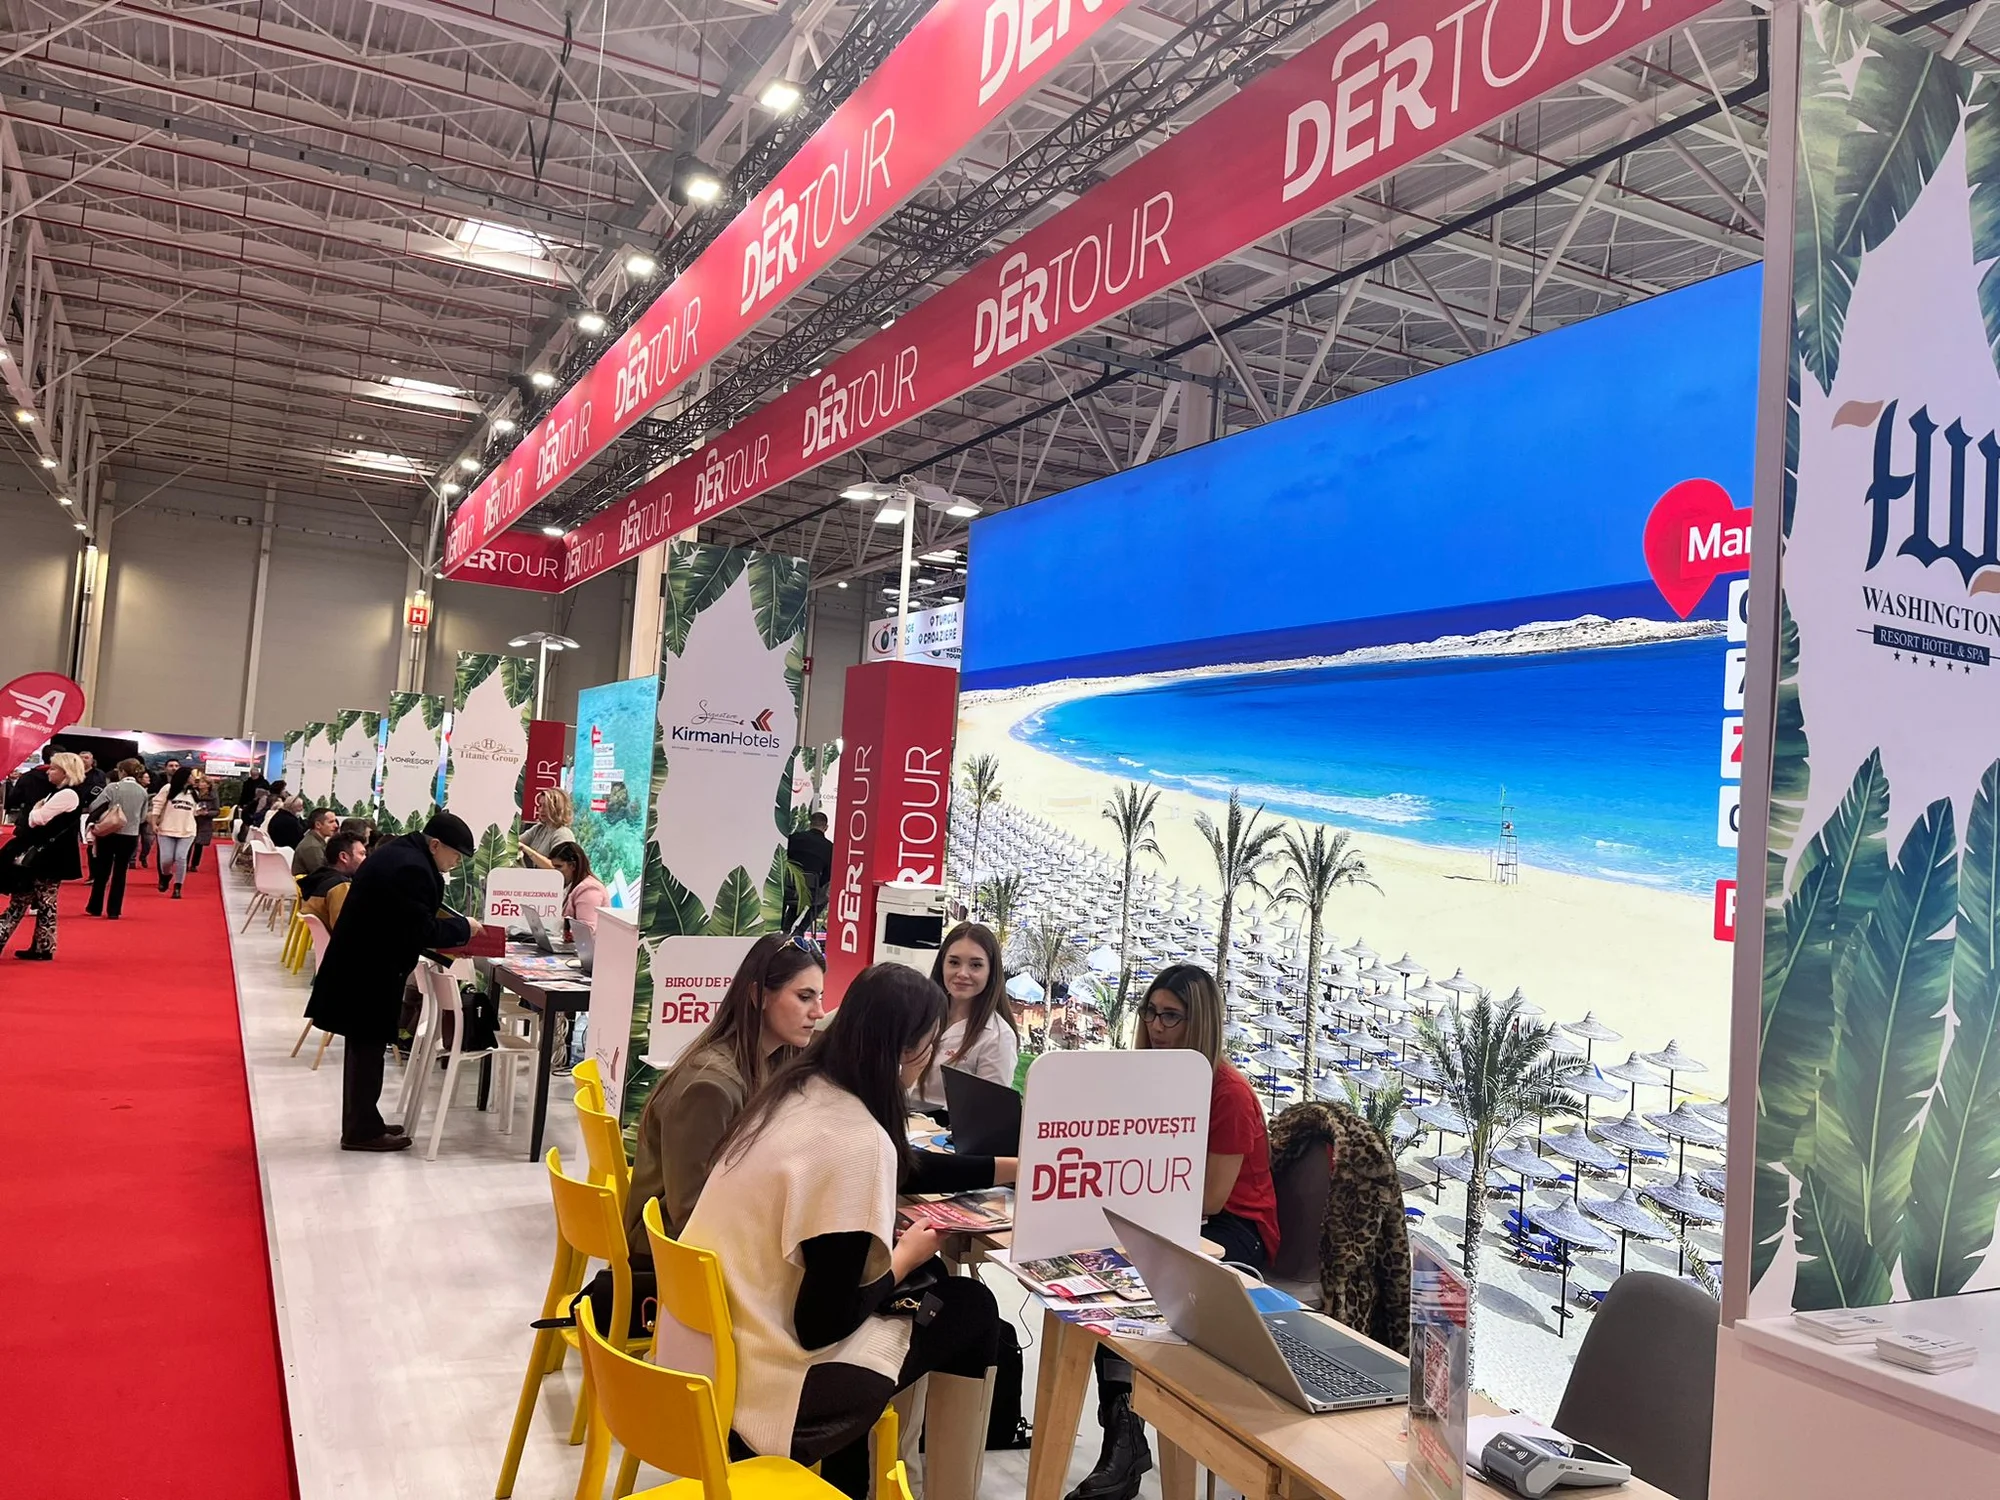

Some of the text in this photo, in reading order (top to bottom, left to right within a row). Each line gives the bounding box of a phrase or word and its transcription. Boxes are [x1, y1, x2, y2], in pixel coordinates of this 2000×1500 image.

[740, 108, 895, 317] DERTOUR
[972, 191, 1173, 369] DERTOUR
[613, 299, 702, 424] DERTOUR
[802, 345, 918, 459] DERTOUR
[536, 401, 592, 491] DERTOUR
[483, 467, 523, 536] DERTOUR
[693, 434, 770, 516] DERTOUR
[445, 514, 475, 568] DERTOUR
[618, 492, 673, 555] DERTOUR
[564, 532, 605, 583] DERTOUR
[1862, 585, 2000, 637] WASHINGTON
[1880, 628, 1985, 662] RESORT HOTEL & SPA
[390, 756, 434, 766] VONRESORT
[460, 751, 519, 765] Titanic Group
[671, 725, 780, 749] KirmanHotels
[838, 745, 873, 954] DERTOUR
[665, 976, 703, 988] BIROU
[705, 977, 722, 988] DE
[1037, 1119, 1094, 1140] BIROU
[1096, 1118, 1120, 1137] DE
[1031, 1147, 1193, 1202] DERTOUR
